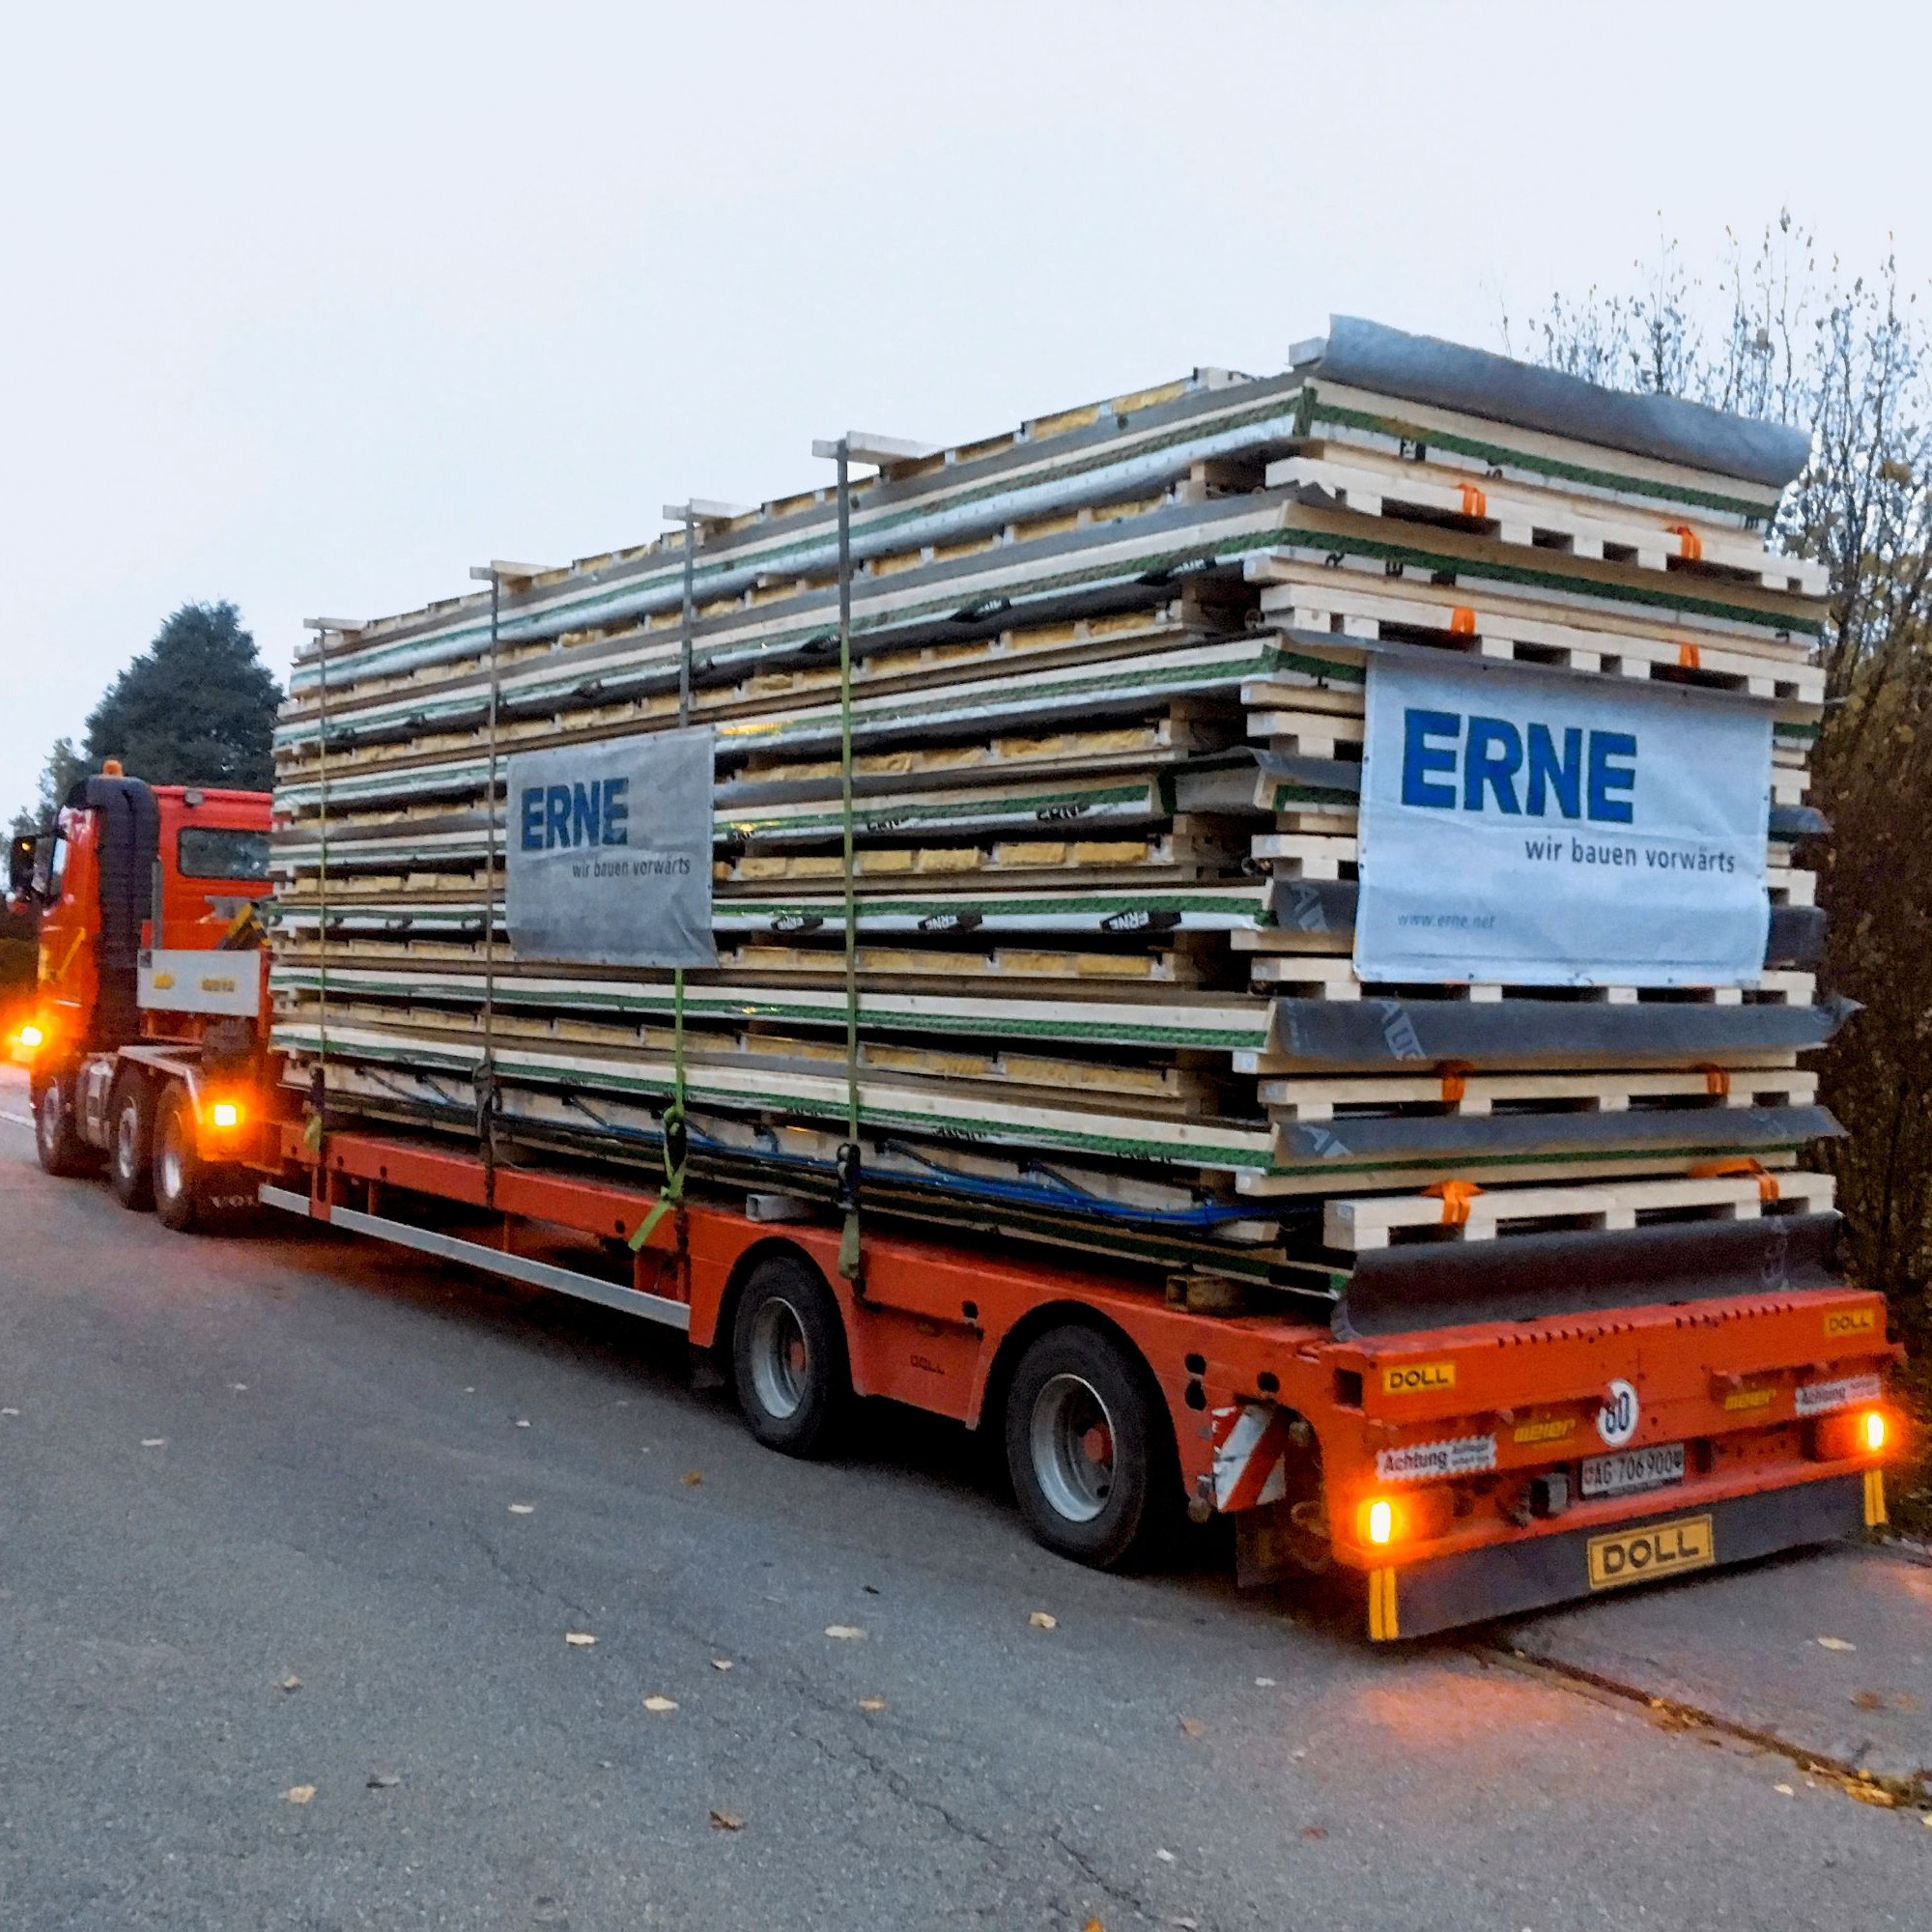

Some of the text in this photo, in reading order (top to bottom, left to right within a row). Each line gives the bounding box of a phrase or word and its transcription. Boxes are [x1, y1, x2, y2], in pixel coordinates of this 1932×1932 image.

[1401, 707, 1637, 825] ERNE
[521, 776, 629, 851] ERNE
[572, 859, 590, 878] wir
[594, 854, 629, 877] bauen
[1525, 835, 1735, 873] wir bauen vorwärts
[1397, 911, 1495, 928] www.erne.net
[1829, 1314, 1870, 1331] DOLL
[1390, 1368, 1448, 1388] DOLL
[1384, 1451, 1448, 1471] Achtung
[1604, 1529, 1699, 1574] DOLL
